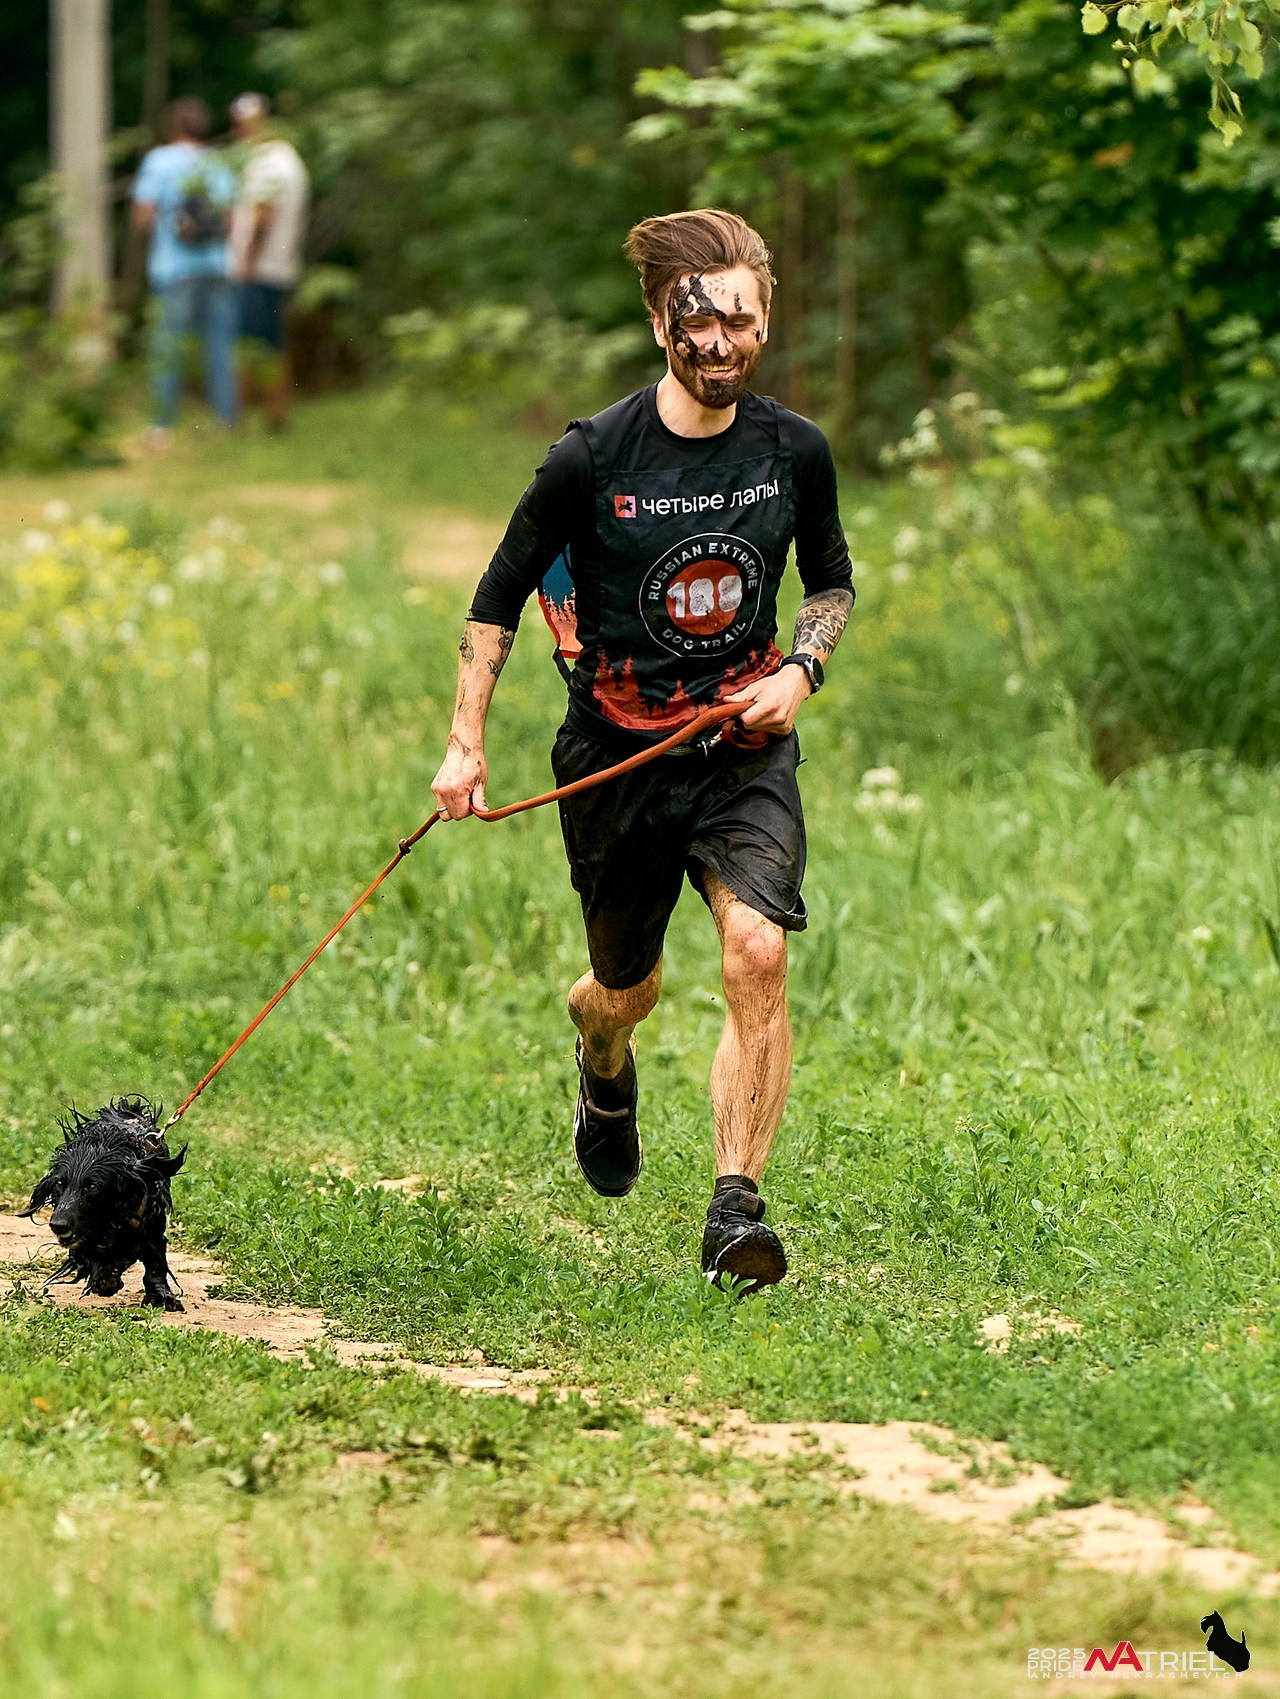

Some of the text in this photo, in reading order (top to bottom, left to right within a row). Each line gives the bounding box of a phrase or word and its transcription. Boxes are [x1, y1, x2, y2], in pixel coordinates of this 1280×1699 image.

[641, 479, 780, 515] четыре лапы
[647, 542, 759, 601] RUSSIAN EXTREME
[662, 622, 747, 650] DOG TRAIL
